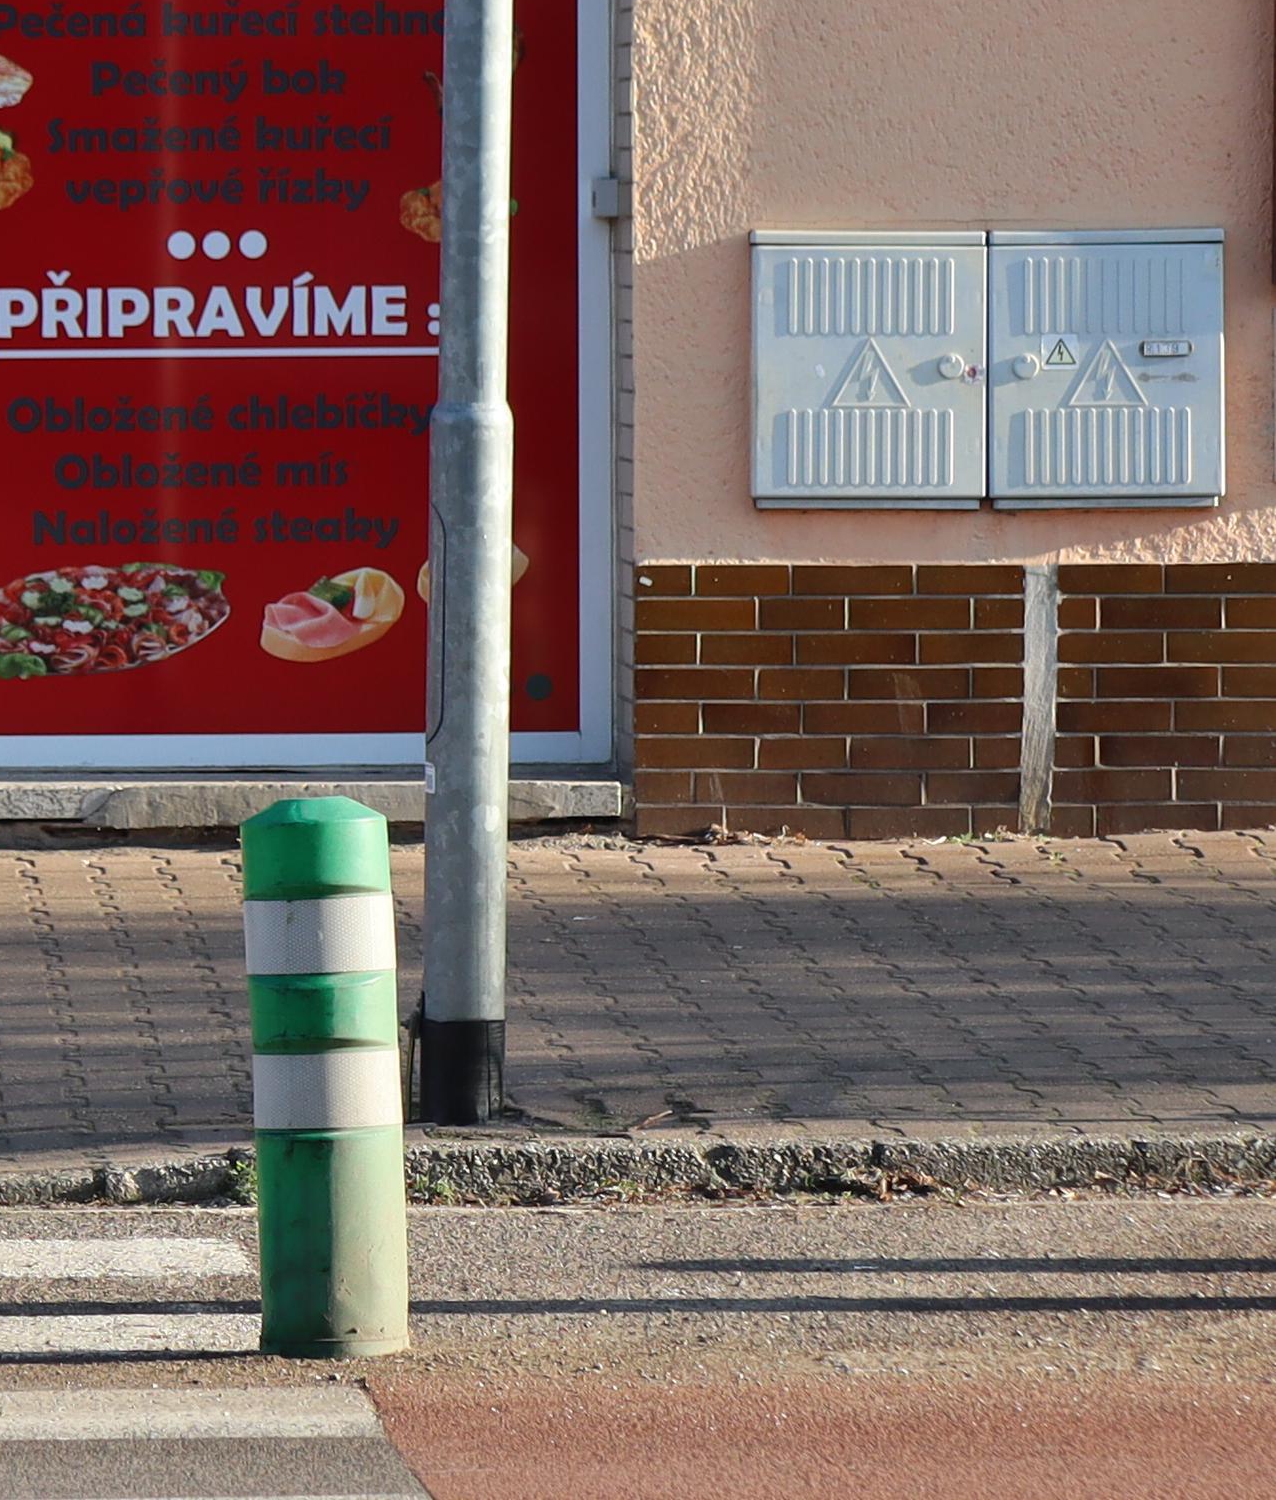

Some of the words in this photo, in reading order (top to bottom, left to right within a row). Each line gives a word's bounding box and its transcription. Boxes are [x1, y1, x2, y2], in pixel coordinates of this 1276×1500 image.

[162, 0, 299, 38] kuřecí
[92, 60, 247, 102] Pečený
[263, 59, 346, 96] bok
[47, 115, 241, 155] Smažené
[255, 114, 392, 152] kuřecí
[66, 168, 243, 211] vepřové
[257, 167, 371, 211] řízky
[7, 395, 213, 434] Obložené
[228, 391, 435, 437] chlebíčky
[54, 452, 262, 492] Obložené
[276, 451, 349, 486] mís
[33, 507, 240, 546] Naložené
[253, 506, 399, 549] steaky
